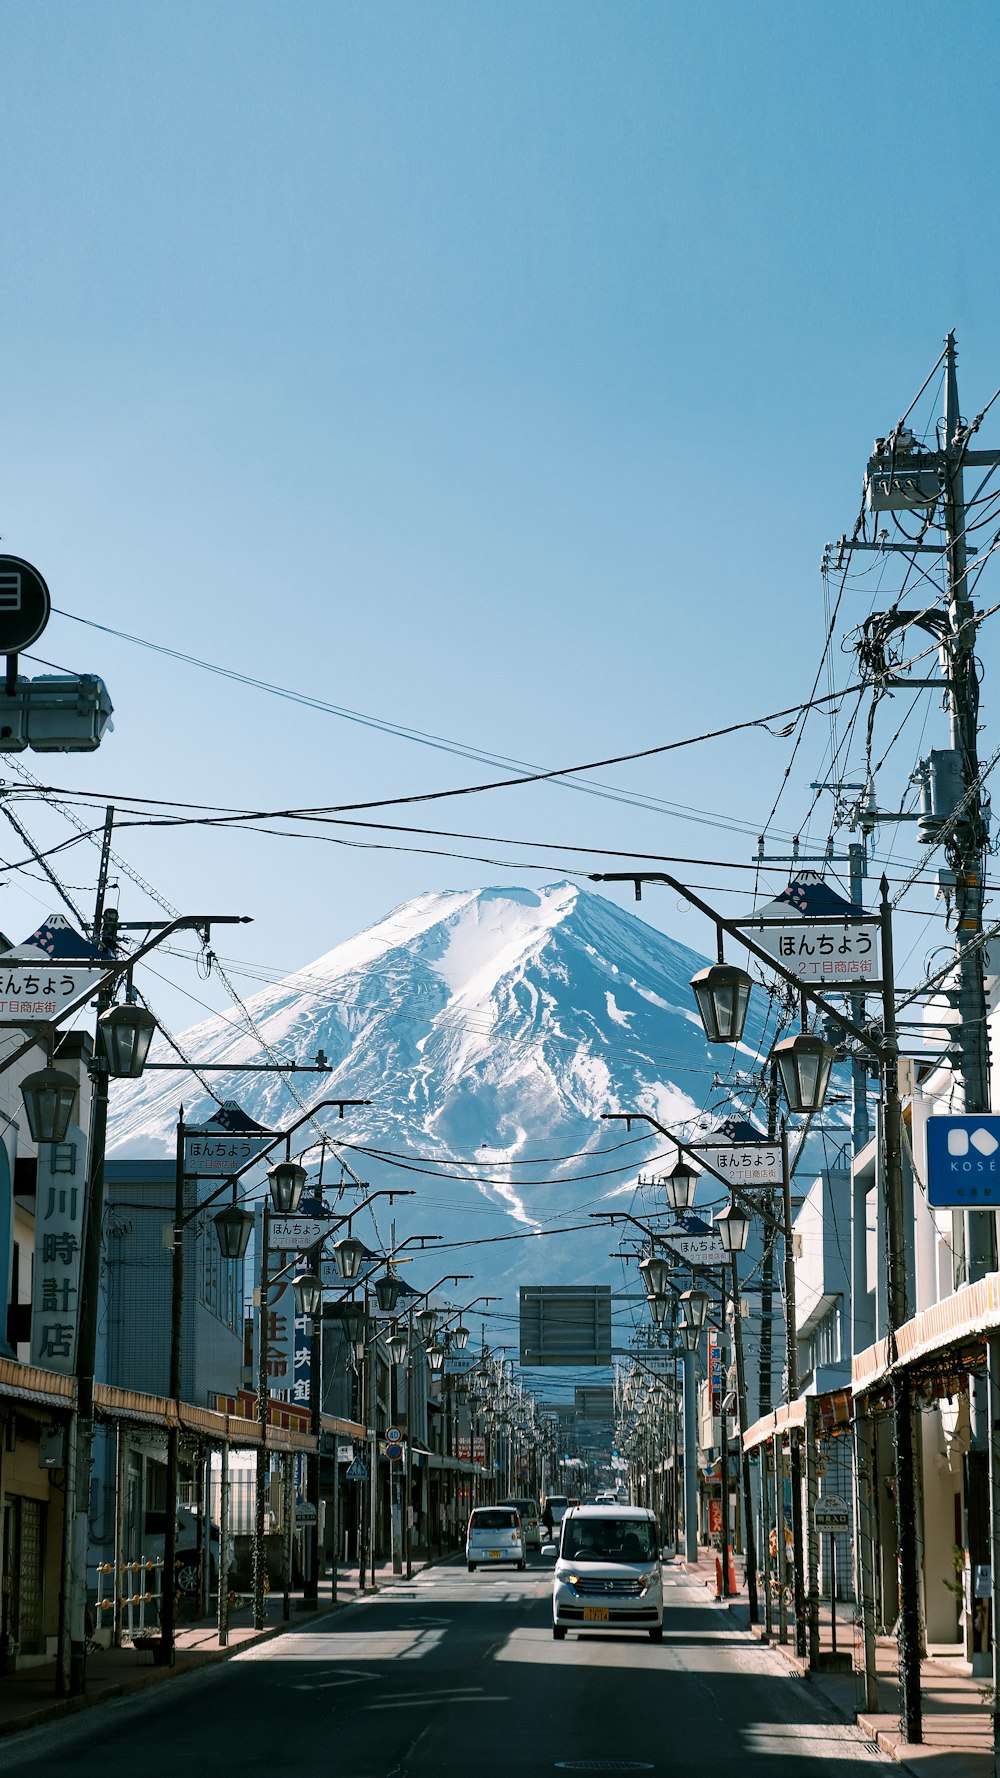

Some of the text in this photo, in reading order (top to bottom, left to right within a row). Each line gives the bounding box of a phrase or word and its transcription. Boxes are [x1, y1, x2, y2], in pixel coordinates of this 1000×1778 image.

[780, 933, 872, 956] ほんちょう
[798, 960, 872, 974] 2丁目商店街
[0, 974, 75, 996] んちょう
[190, 1142, 251, 1157] ほんちょう
[717, 1152, 776, 1167] ほんちょう
[951, 1159, 996, 1172] KOSÉ
[273, 1223, 321, 1236] ほんちょう
[39, 1142, 78, 1358] 日川時計店
